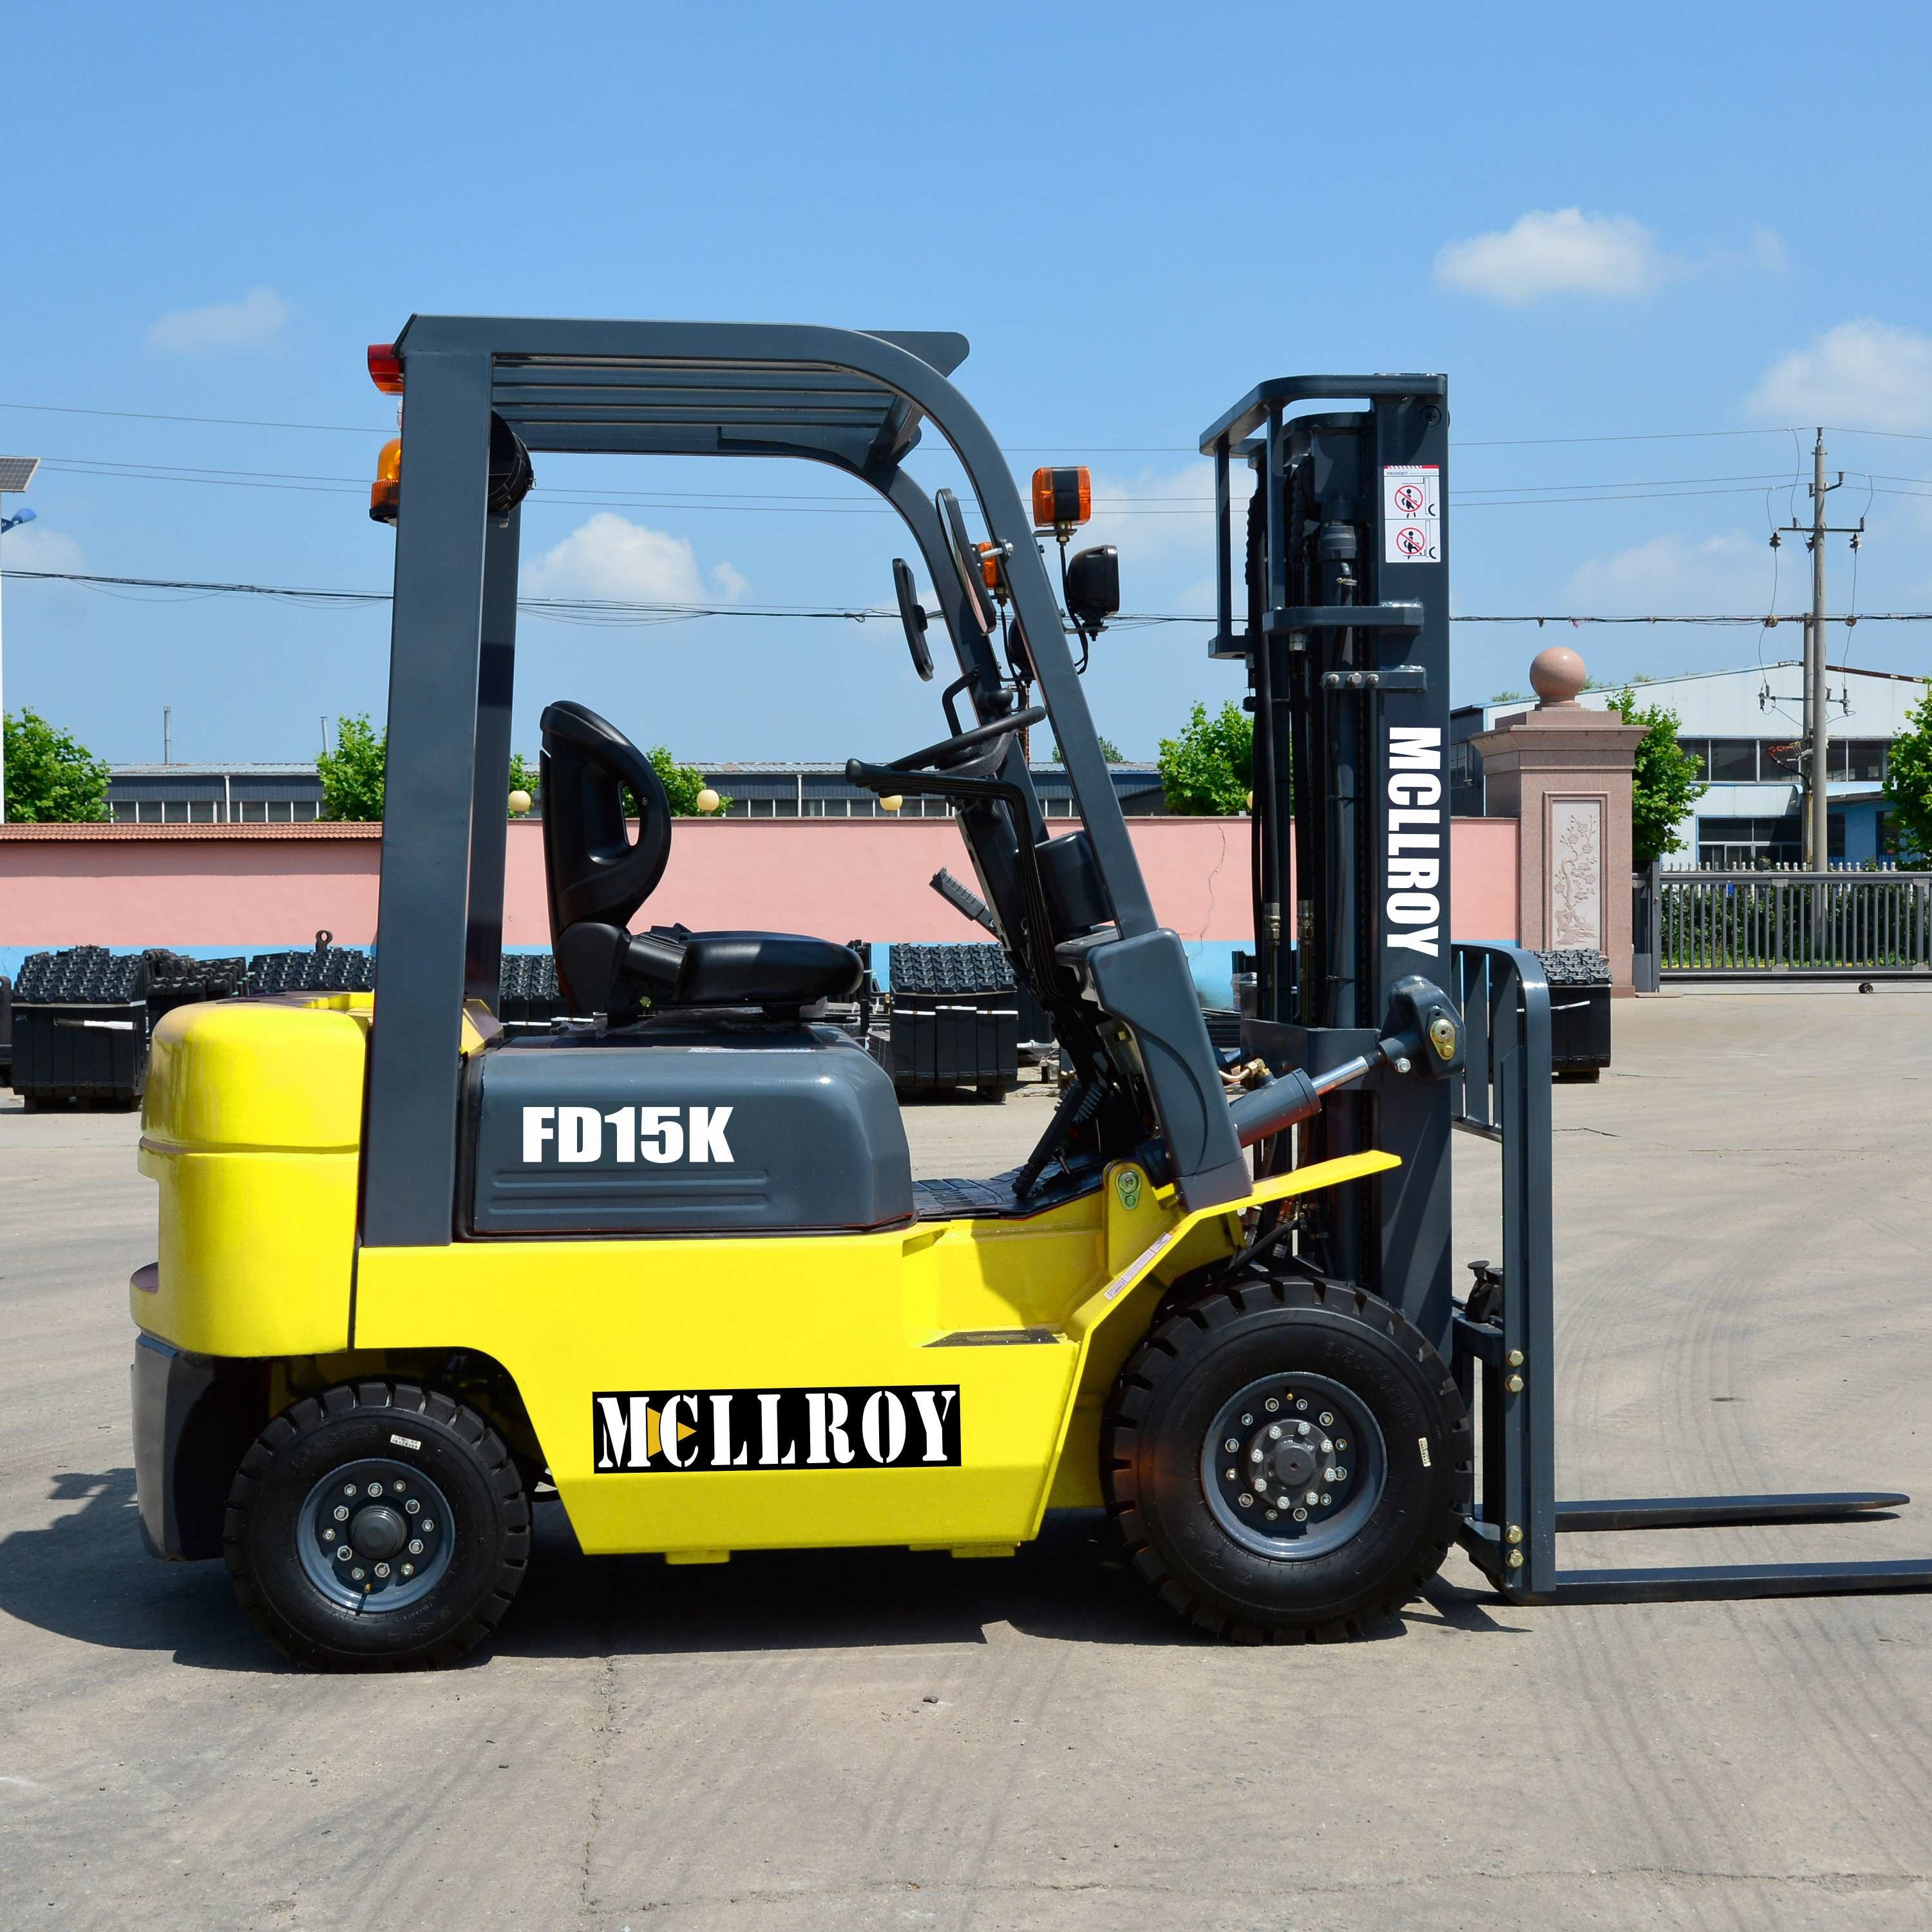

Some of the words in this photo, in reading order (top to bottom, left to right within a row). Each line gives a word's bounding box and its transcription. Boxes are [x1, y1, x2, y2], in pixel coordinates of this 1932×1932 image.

[1387, 727, 1441, 956] MCLLROY
[524, 1107, 734, 1163] FD15K
[598, 1391, 956, 1467] MCLLROY
